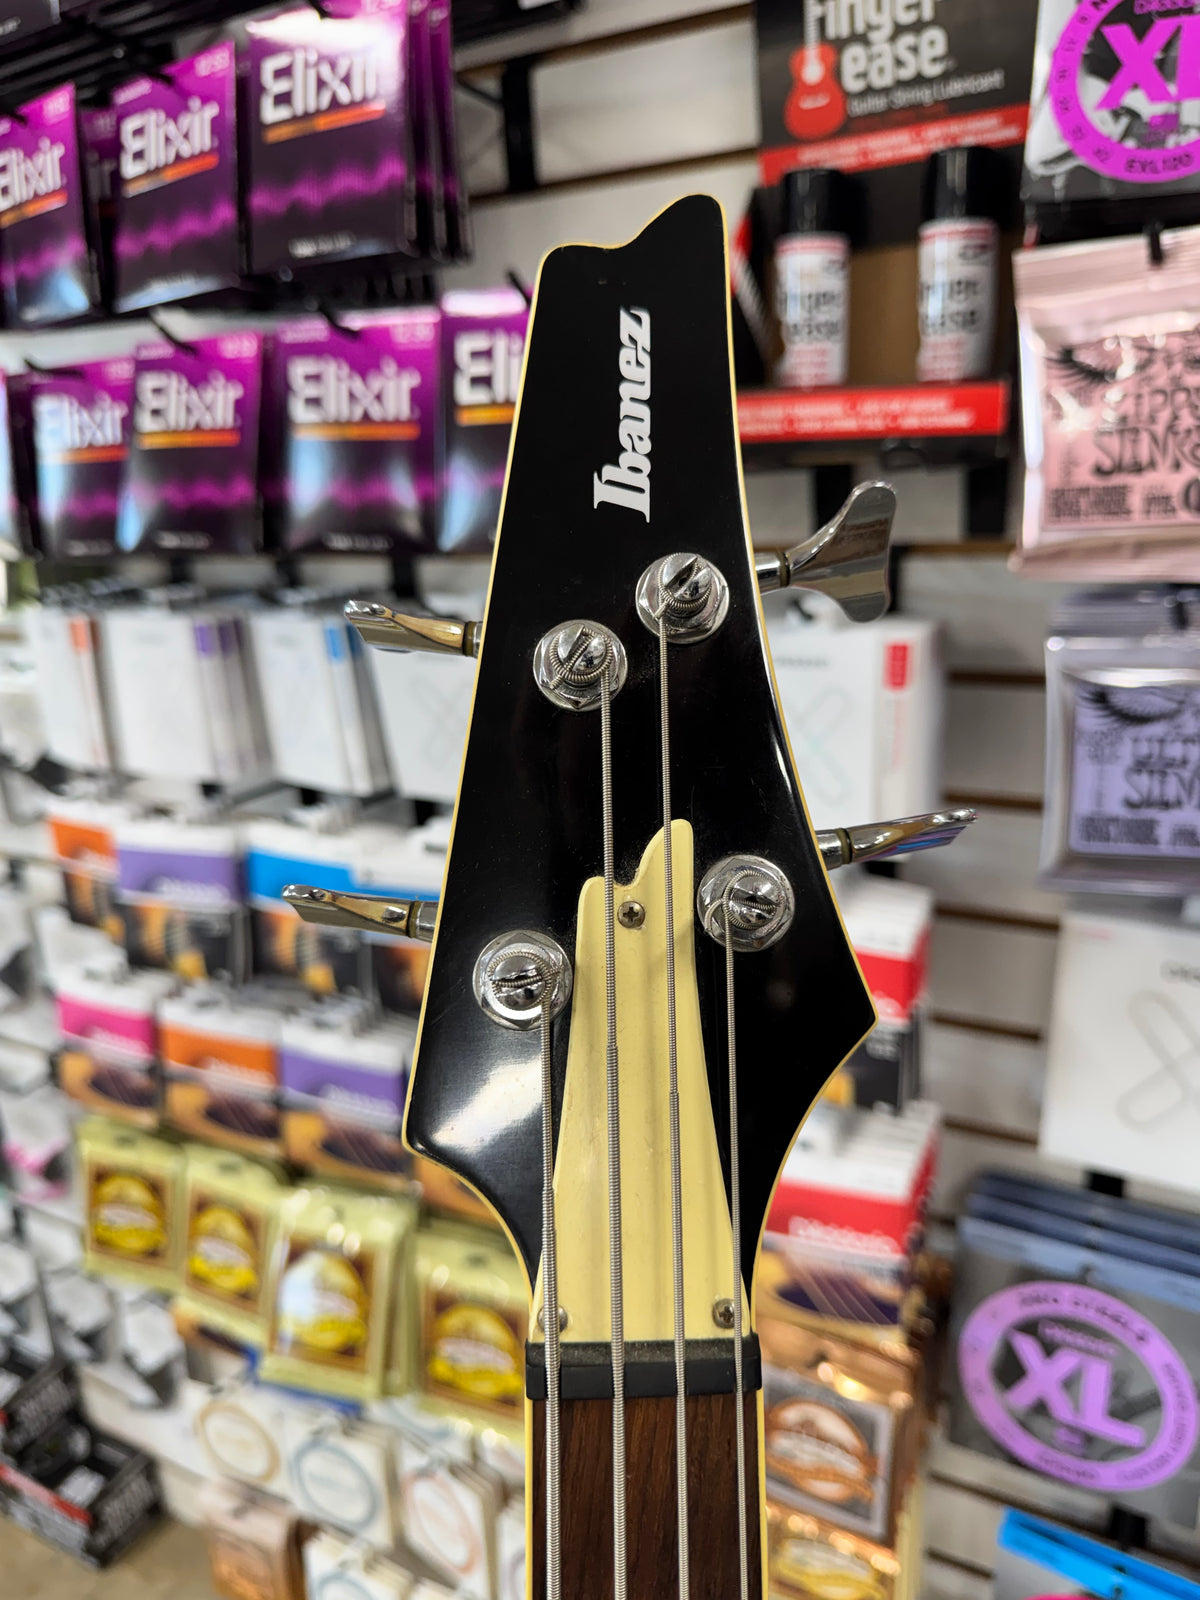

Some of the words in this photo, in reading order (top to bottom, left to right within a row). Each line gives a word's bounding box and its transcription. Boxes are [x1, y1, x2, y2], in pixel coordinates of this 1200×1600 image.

[841, 25, 948, 93] ease
[120, 96, 220, 180] Elixir
[136, 370, 244, 434] Elixir
[287, 354, 422, 424] Elixir
[453, 327, 524, 405] Eli
[593, 306, 652, 523] Ibanez
[1004, 1326, 1146, 1449] XL
